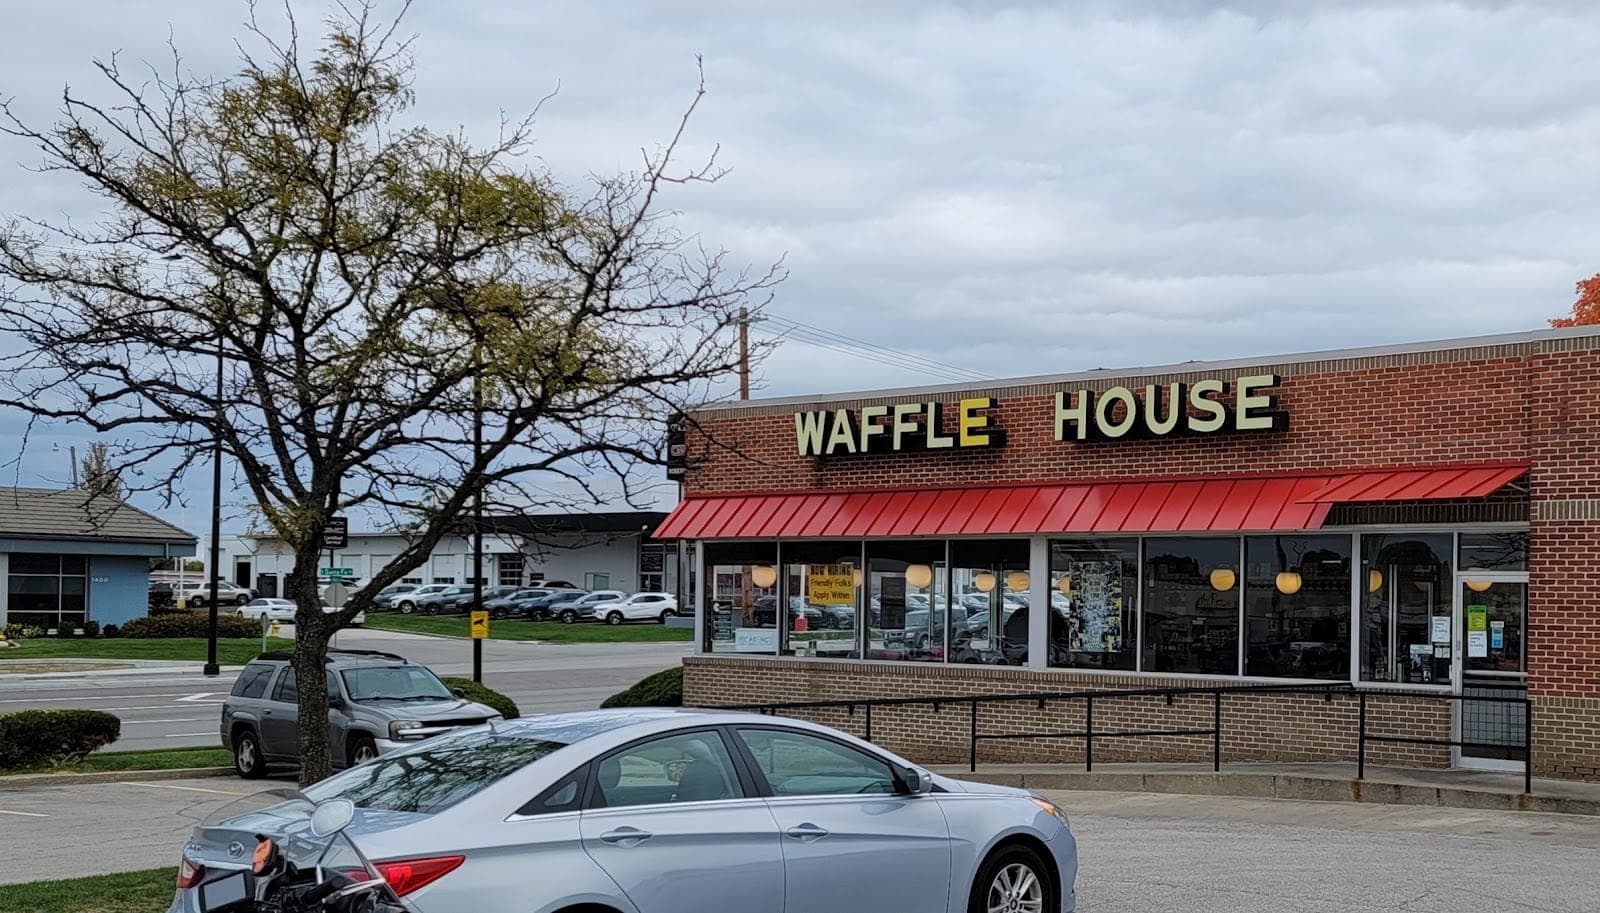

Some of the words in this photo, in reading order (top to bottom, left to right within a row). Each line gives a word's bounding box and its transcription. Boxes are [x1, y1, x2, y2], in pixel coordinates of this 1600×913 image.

[795, 397, 991, 456] WAFFLE
[1055, 375, 1277, 442] HOUSE
[811, 565, 825, 576] NOW
[827, 565, 851, 576] HIRING
[811, 578, 833, 588] Friendly
[834, 578, 851, 587] Folks
[813, 590, 830, 600] Apply
[831, 590, 850, 599] Within
